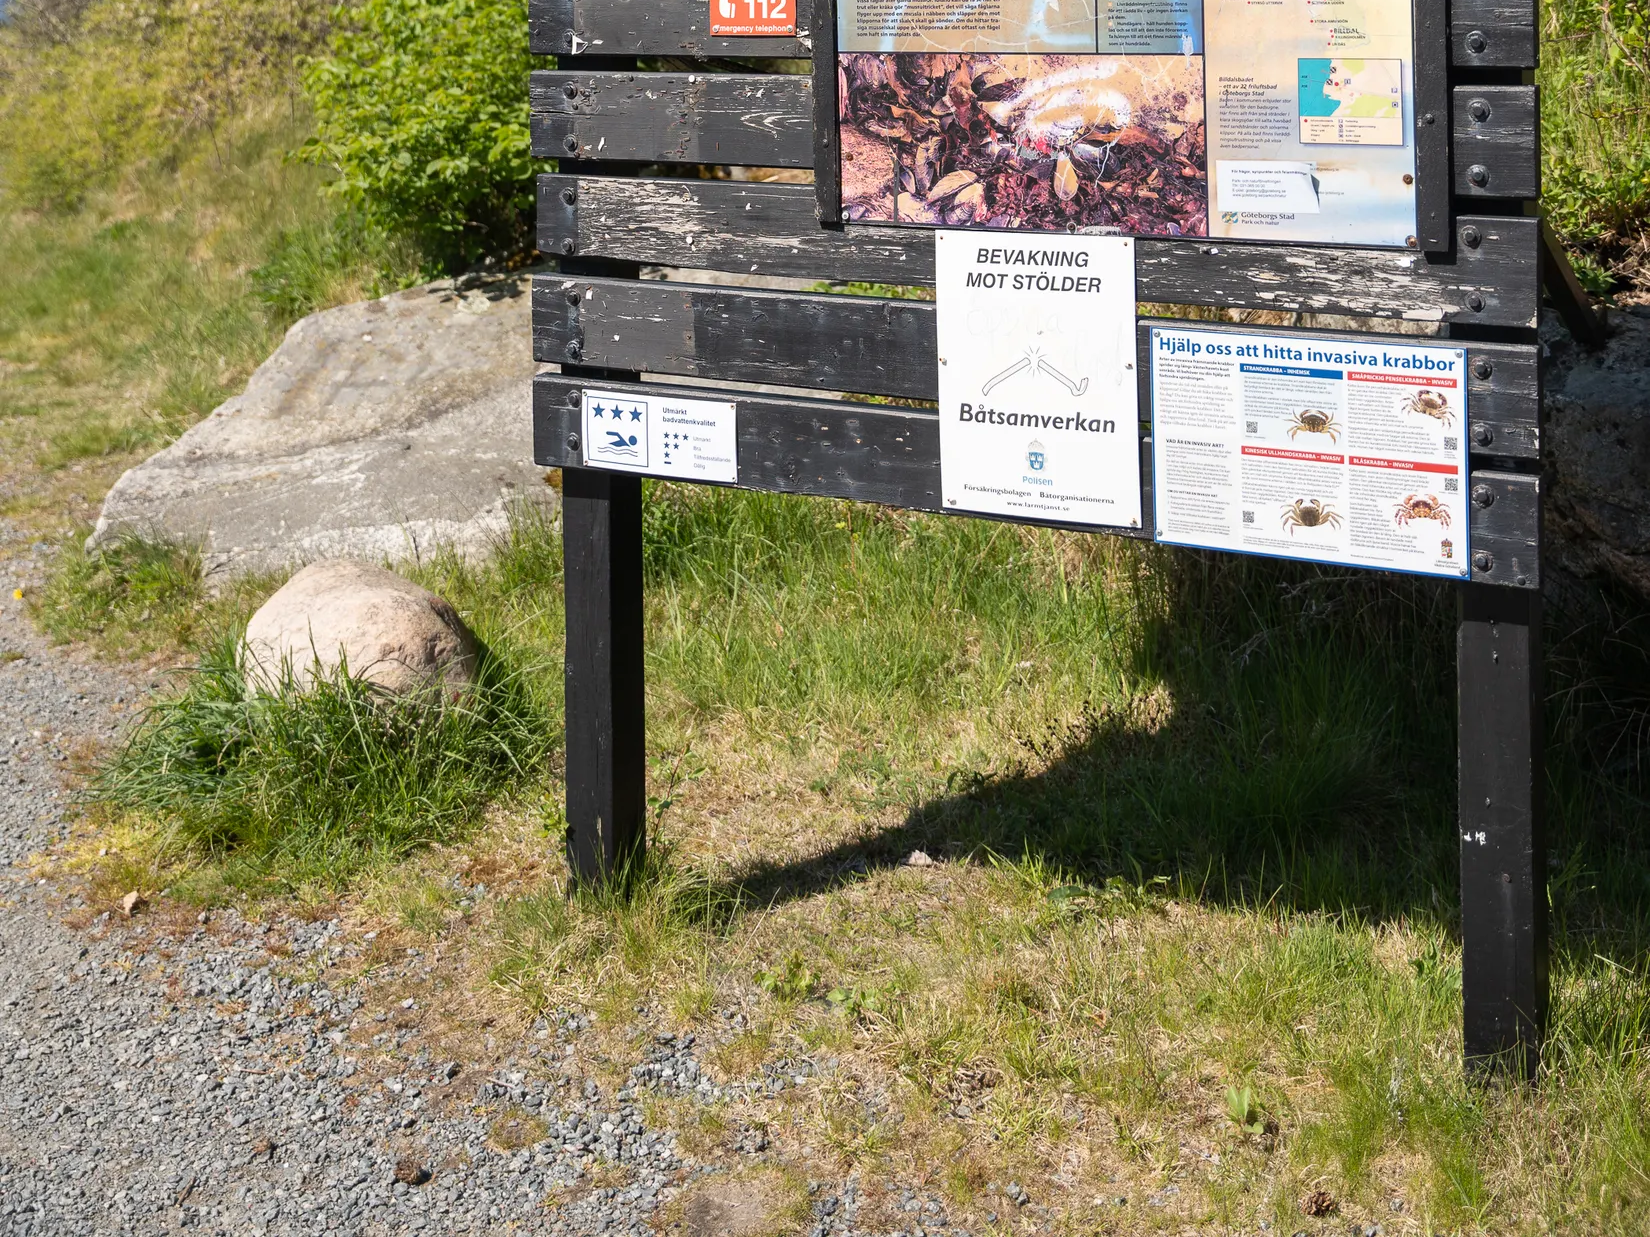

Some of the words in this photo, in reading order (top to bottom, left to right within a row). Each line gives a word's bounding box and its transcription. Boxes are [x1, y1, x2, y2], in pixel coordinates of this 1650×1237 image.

[716, 25, 753, 33] mergency
[756, 25, 790, 33] telephon
[1241, 212, 1277, 220] Göteborgs
[977, 248, 1089, 267] BEVAKNING
[966, 272, 1008, 288] MOT
[1012, 271, 1101, 293] STÖLDER
[1159, 337, 1201, 356] Hjälp
[1206, 344, 1232, 355] oss
[1236, 345, 1259, 357] att
[1263, 344, 1302, 361] hitta
[1308, 347, 1377, 366] invasiva
[1383, 352, 1455, 371] krabbor
[1243, 365, 1283, 373] STRANDKRABBA
[1352, 373, 1385, 381] SMÅPRICKIG
[1386, 376, 1427, 384] PENSELKRABBA
[663, 407, 687, 415] Utmärkt
[663, 416, 716, 427] badvattenkvalitet
[959, 403, 1115, 433] Båtsamverkan
[1268, 450, 1316, 459] ULLHANDSKRABBA
[1353, 458, 1387, 467] BLÅSKRABBA
[1023, 476, 1053, 486] Polisen
[964, 484, 1031, 497] Försäkringsbolagen
[1040, 491, 1114, 504] Båtorganisationerna
[1007, 501, 1070, 511] www.larmtjanst.se
